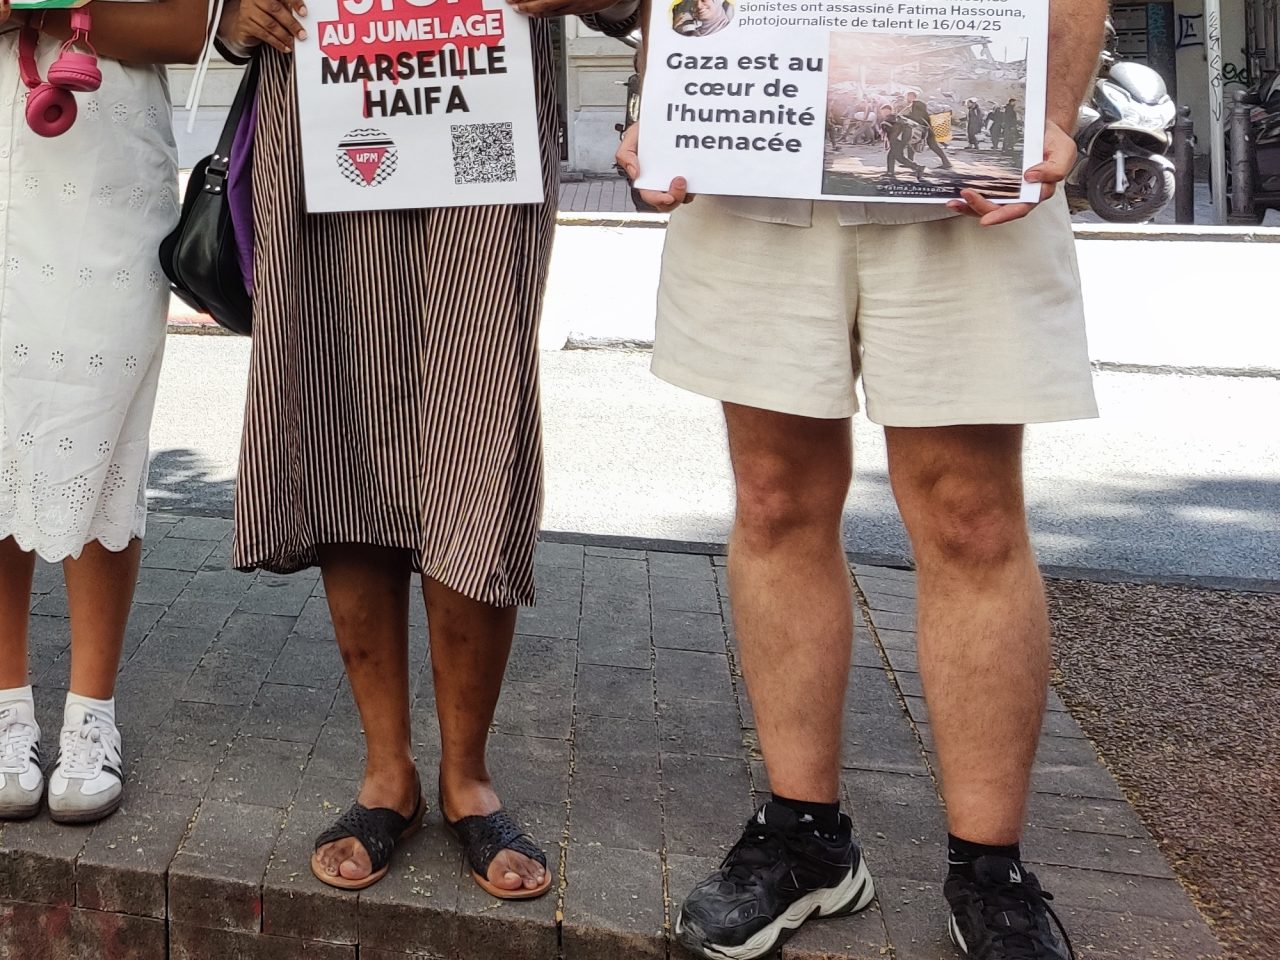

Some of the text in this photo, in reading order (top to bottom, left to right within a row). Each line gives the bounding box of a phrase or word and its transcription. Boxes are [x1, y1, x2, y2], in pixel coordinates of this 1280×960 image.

[739, 1, 1026, 19] sionistes ont assassiné Fatima Hassouna,
[321, 13, 502, 47] AU JUMELAGE
[738, 15, 1002, 32] photojournaliste de talent le 16/04/25
[321, 46, 507, 84] MARSEILLE
[666, 52, 824, 72] Gaza est au
[684, 78, 799, 98] cœur de
[365, 84, 470, 118] HAIFA
[666, 103, 816, 127] l'humanité
[675, 132, 803, 153] menacée
